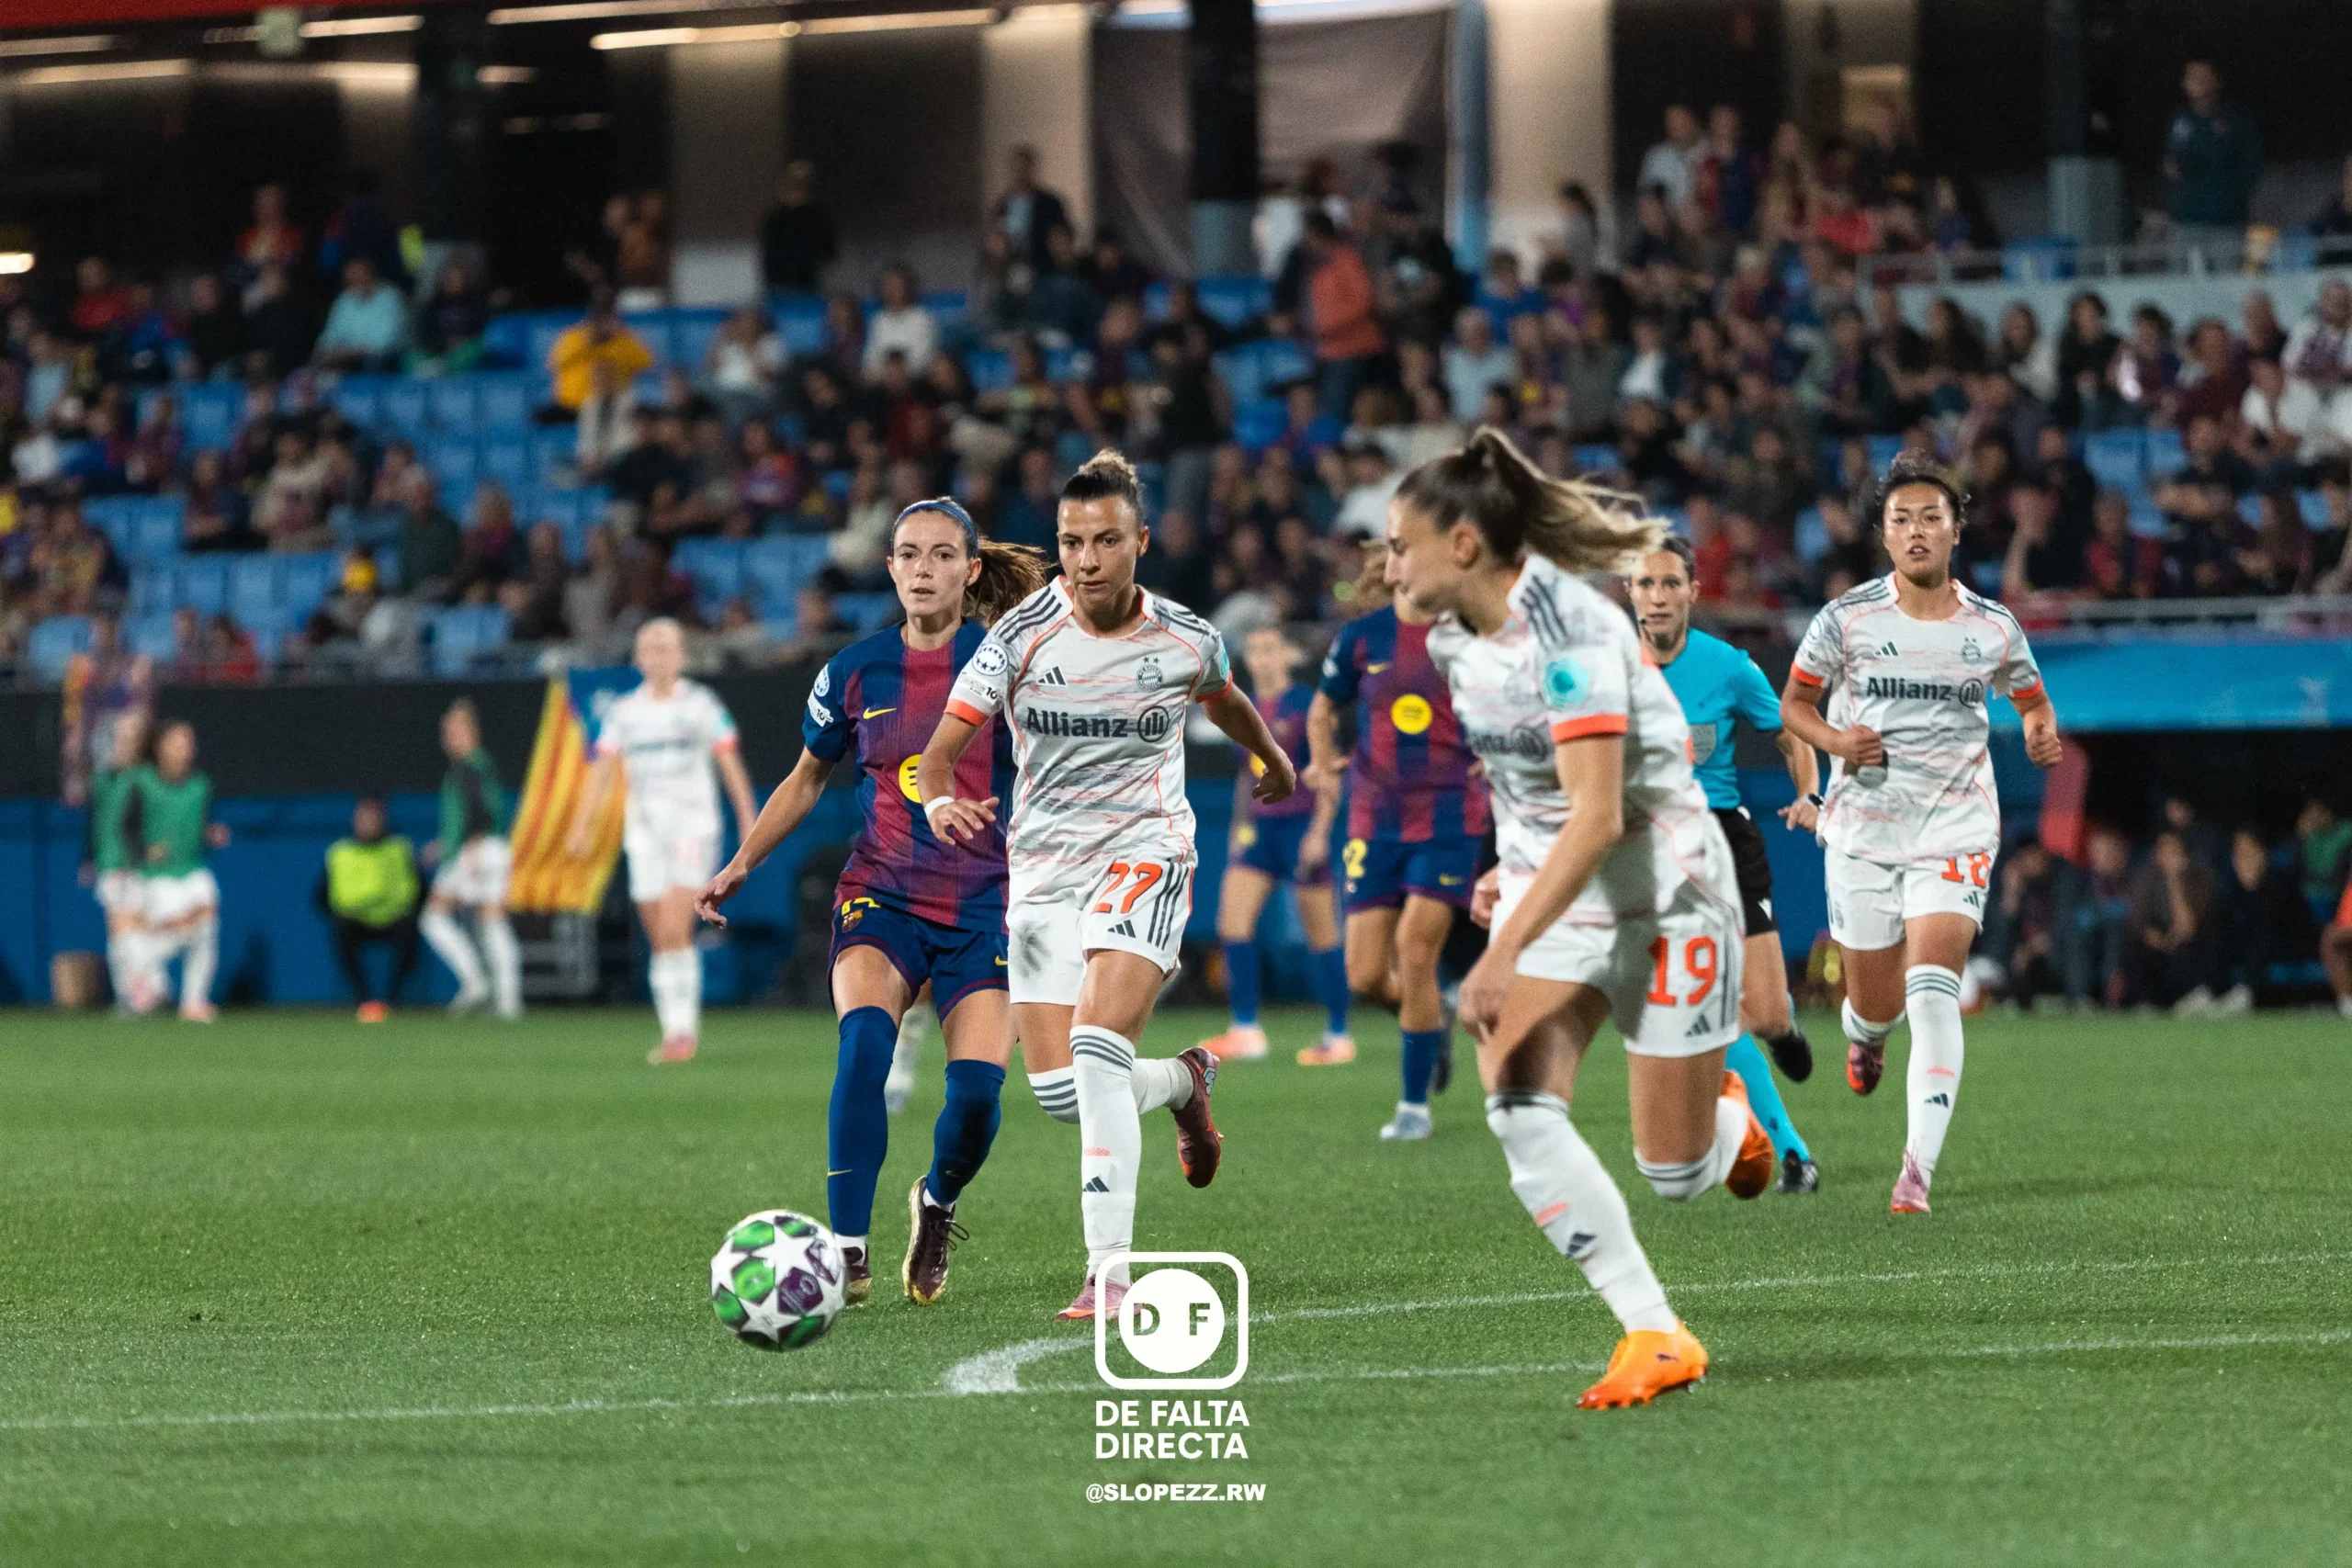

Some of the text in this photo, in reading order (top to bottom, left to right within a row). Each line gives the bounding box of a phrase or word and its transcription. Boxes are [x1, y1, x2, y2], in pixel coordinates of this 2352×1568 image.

[1866, 675, 1952, 701] Allianz
[1026, 706, 1129, 738] Allianz
[1090, 862, 1163, 915] 27
[1940, 850, 1992, 890] 18
[1646, 935, 1717, 1007] 19
